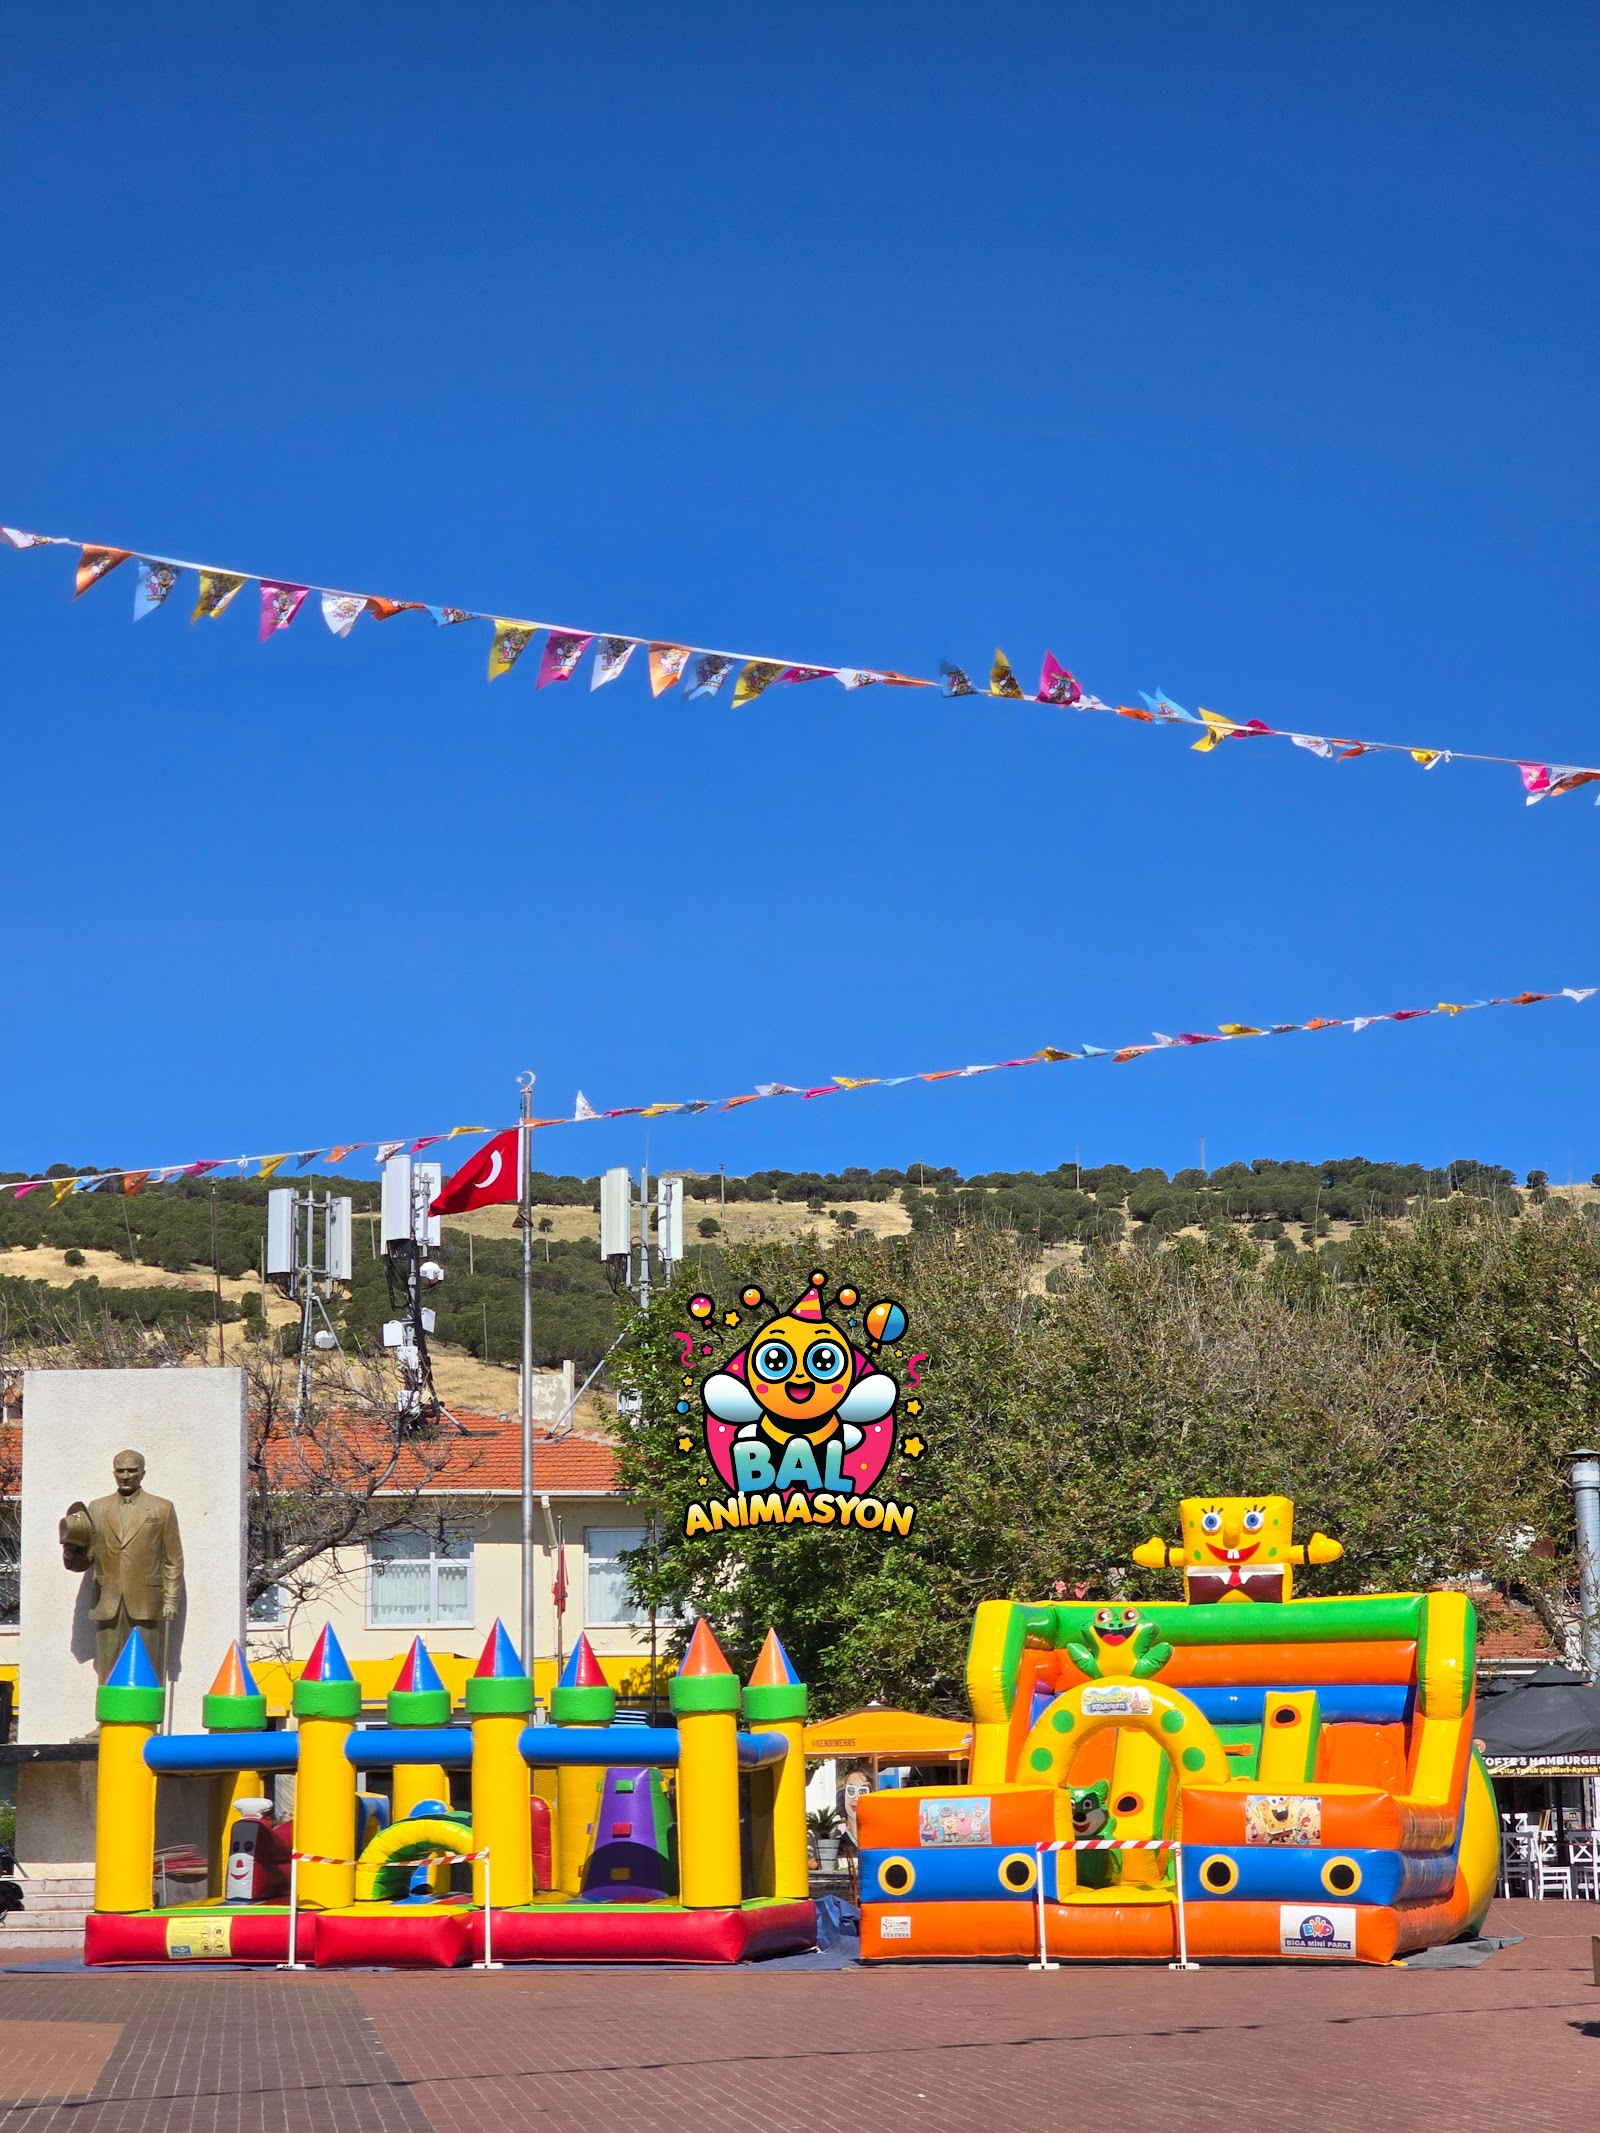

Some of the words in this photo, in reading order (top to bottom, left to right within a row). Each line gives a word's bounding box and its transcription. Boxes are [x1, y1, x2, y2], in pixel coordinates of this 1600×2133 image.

[1520, 1757, 1527, 1766] &
[1286, 1939, 1306, 1947] BİGA
[1307, 1939, 1326, 1948] MİNİ
[1327, 1941, 1349, 1949] PARK
